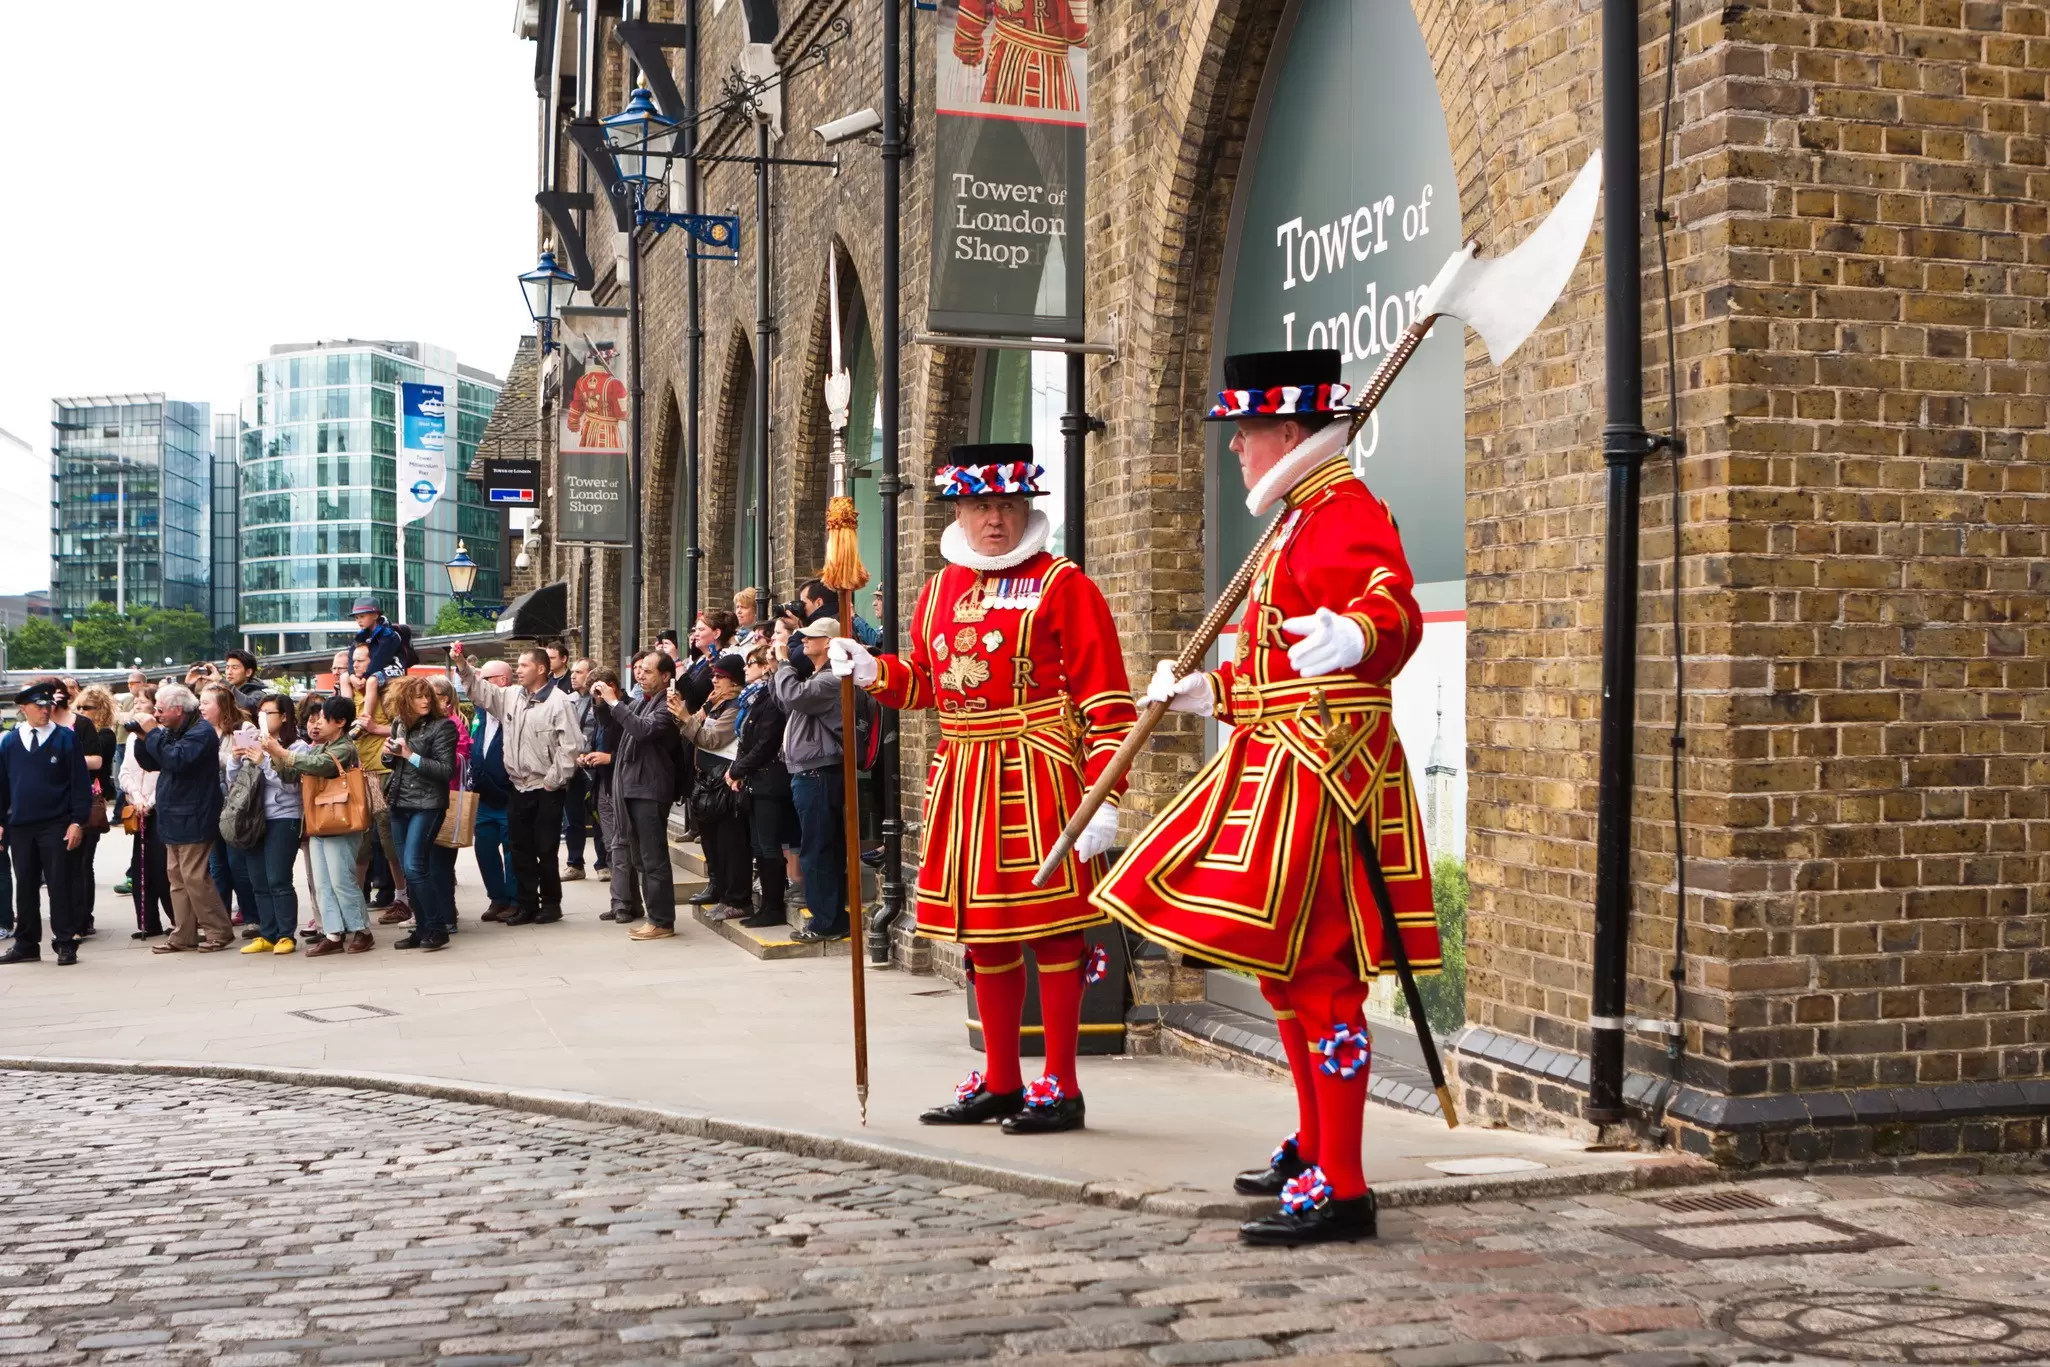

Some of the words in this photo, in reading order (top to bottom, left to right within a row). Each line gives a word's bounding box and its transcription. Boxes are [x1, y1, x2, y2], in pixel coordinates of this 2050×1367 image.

[952, 173, 1043, 203] Tower
[1047, 189, 1068, 206] of
[956, 204, 1067, 236] London
[955, 235, 1029, 269] Shop
[1277, 194, 1395, 291] Tower
[1402, 183, 1433, 242] of
[567, 476, 607, 487] Tower
[569, 489, 618, 500] London
[570, 501, 602, 514] Shop
[1011, 656, 1039, 688] R
